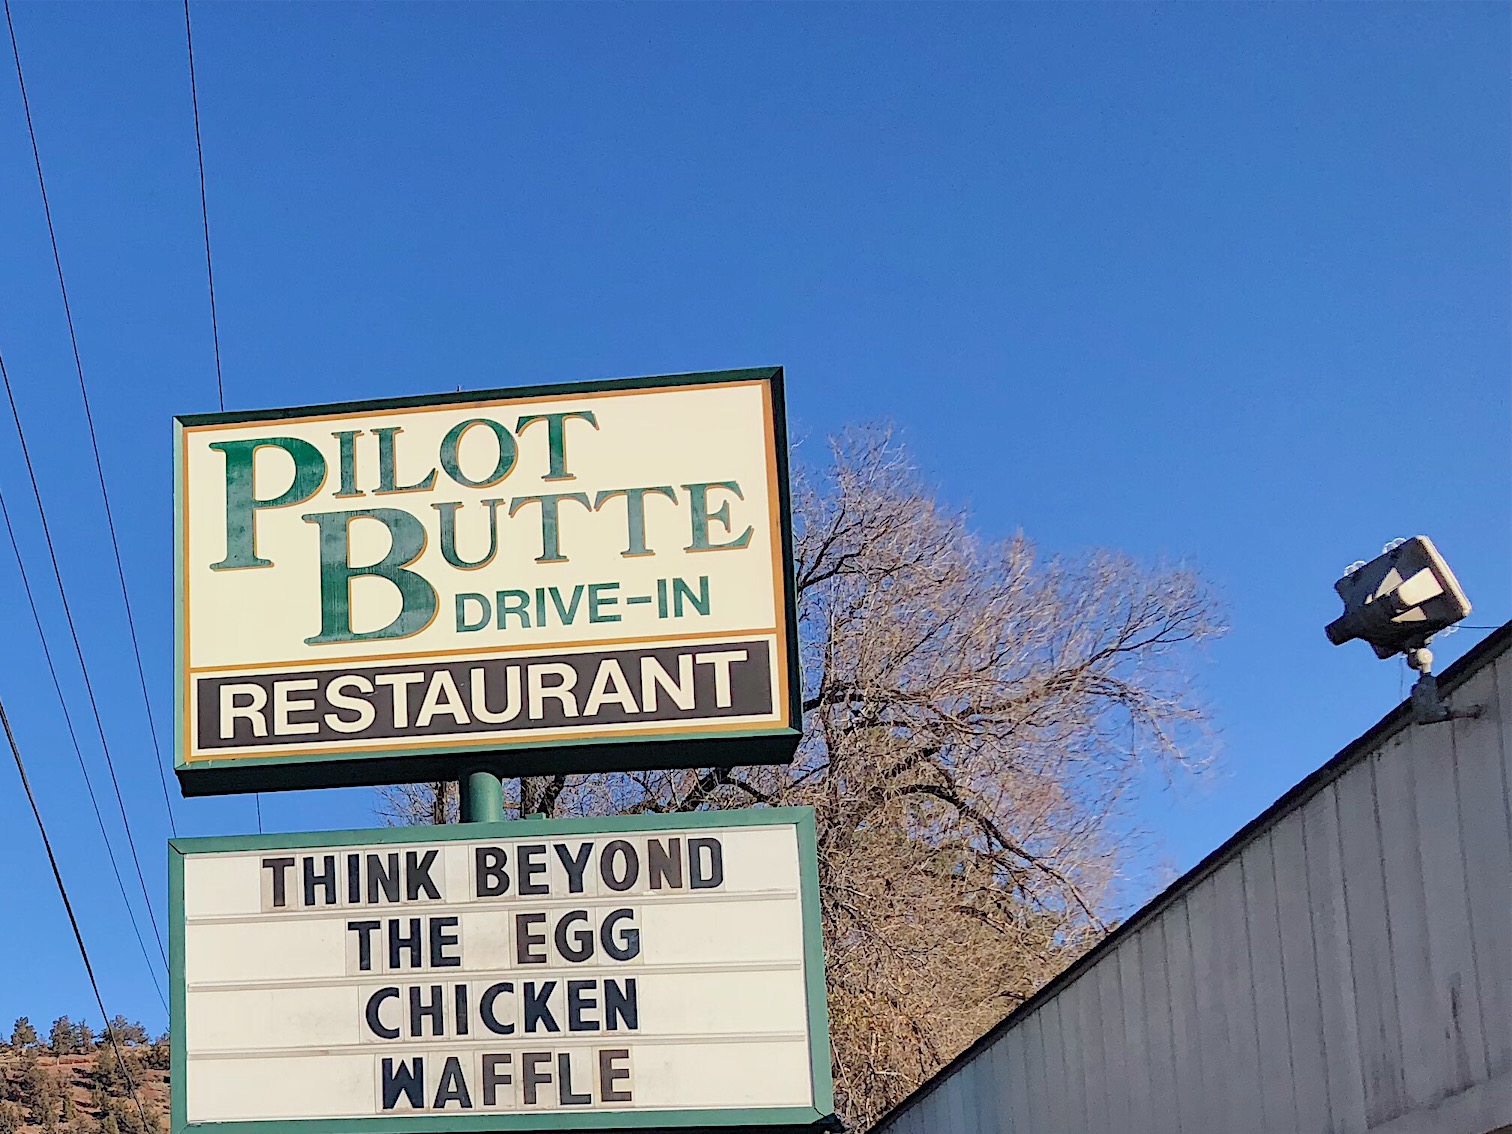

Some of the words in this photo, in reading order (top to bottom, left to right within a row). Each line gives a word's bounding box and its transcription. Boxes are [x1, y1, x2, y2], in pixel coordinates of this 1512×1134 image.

[208, 410, 600, 571] PILOT
[301, 480, 754, 645] BUTTE
[455, 575, 711, 633] DRIVE-IN
[218, 649, 748, 740] RESTAURANT
[262, 848, 443, 908] THINK
[476, 837, 723, 899] BEYOND
[347, 915, 461, 971] THE
[516, 908, 641, 964] EGG
[365, 977, 639, 1039] CHICKEN
[381, 1049, 633, 1110] WAFFLE
